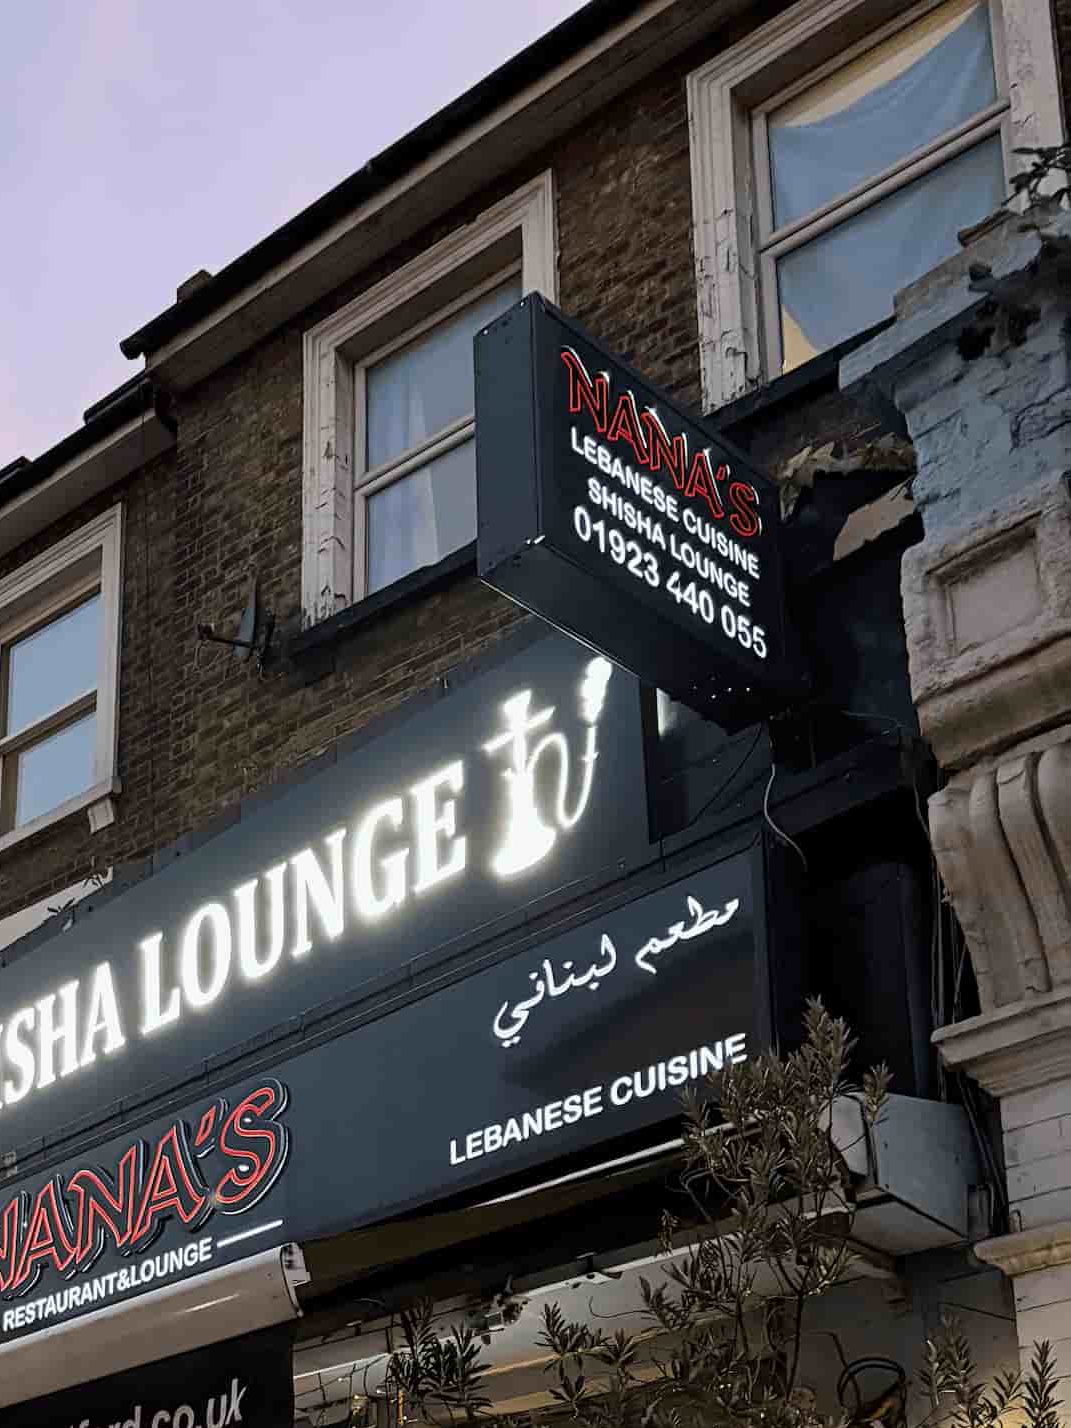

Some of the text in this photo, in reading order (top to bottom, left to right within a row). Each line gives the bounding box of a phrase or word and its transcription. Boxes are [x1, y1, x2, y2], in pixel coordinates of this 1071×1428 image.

[560, 345, 763, 537] NANA'S
[570, 426, 761, 580] LEBANESE CUISINE
[573, 505, 768, 660] 01923 440 055
[587, 477, 751, 608] SHISHA LOUNGE
[140, 759, 467, 1037] LOUNGE
[492, 895, 739, 1048] مطعم لبناني
[449, 1033, 749, 1165] LEBANESE CUISINE
[2, 1237, 213, 1332] RESTAURANT&LOUNGE
